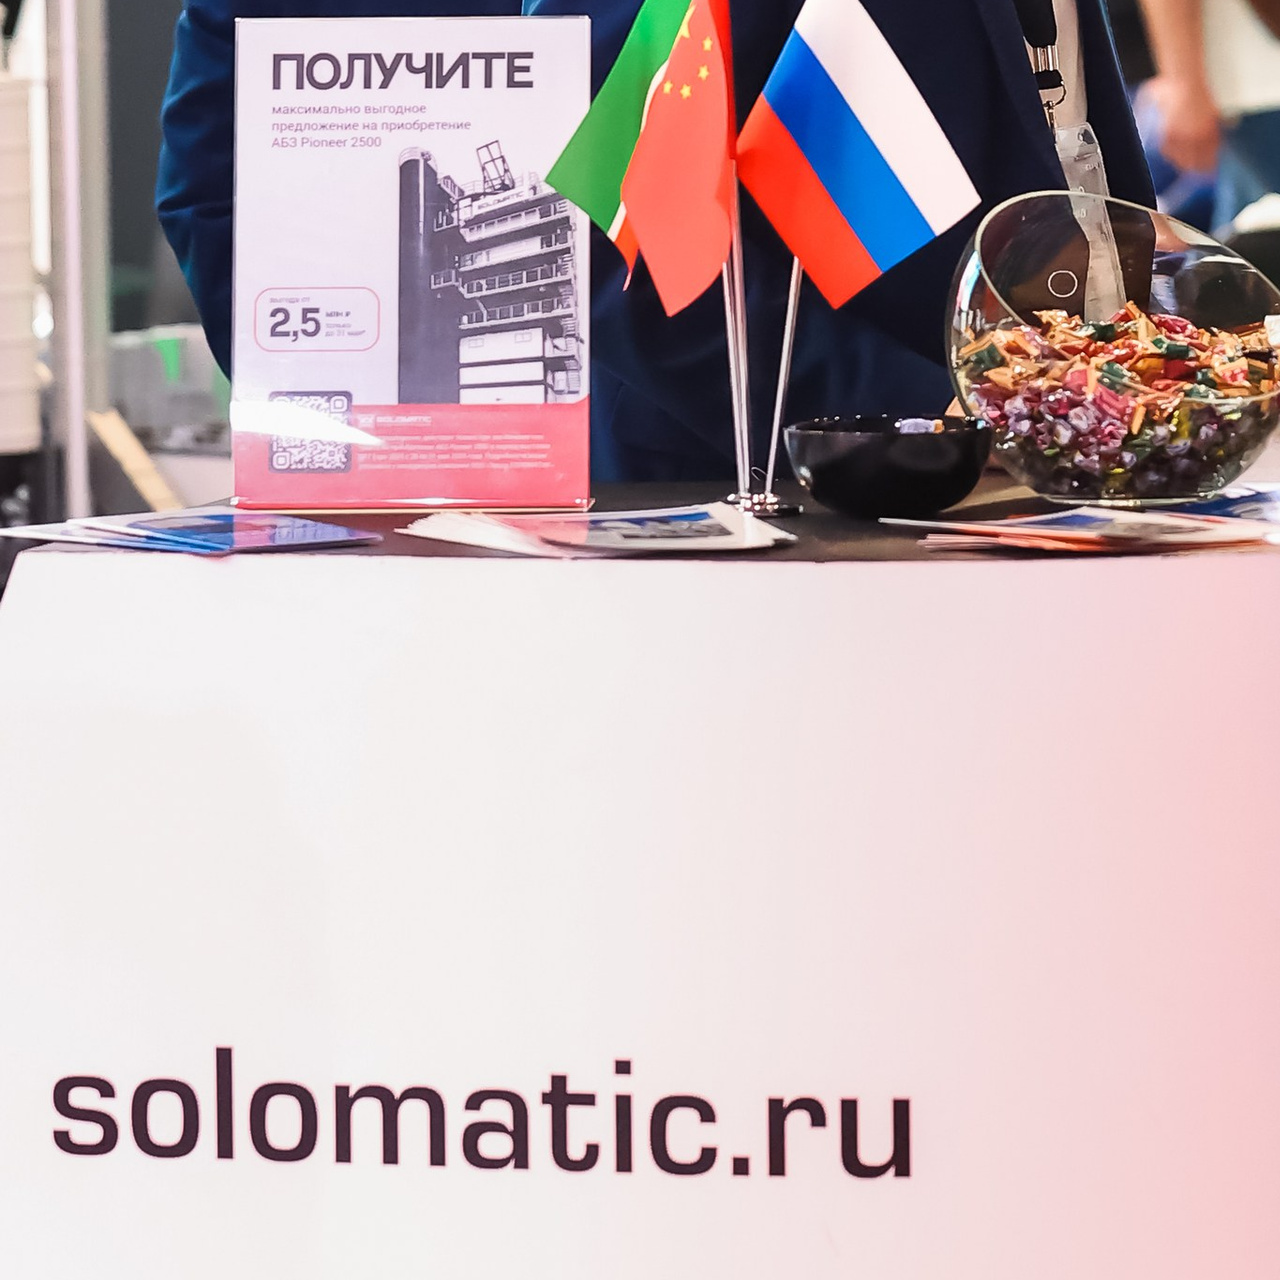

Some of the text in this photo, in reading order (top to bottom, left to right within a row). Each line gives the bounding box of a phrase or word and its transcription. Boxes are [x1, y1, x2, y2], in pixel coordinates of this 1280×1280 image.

[272, 51, 534, 91] ПОЛУЧИТЕ
[271, 104, 427, 117] максимально выгодное
[271, 119, 472, 133] предложение на приобретение
[271, 136, 382, 148] АБЗ Pioneer 2500
[269, 307, 321, 342] 2,5
[52, 1046, 912, 1179] solomatic.ru
